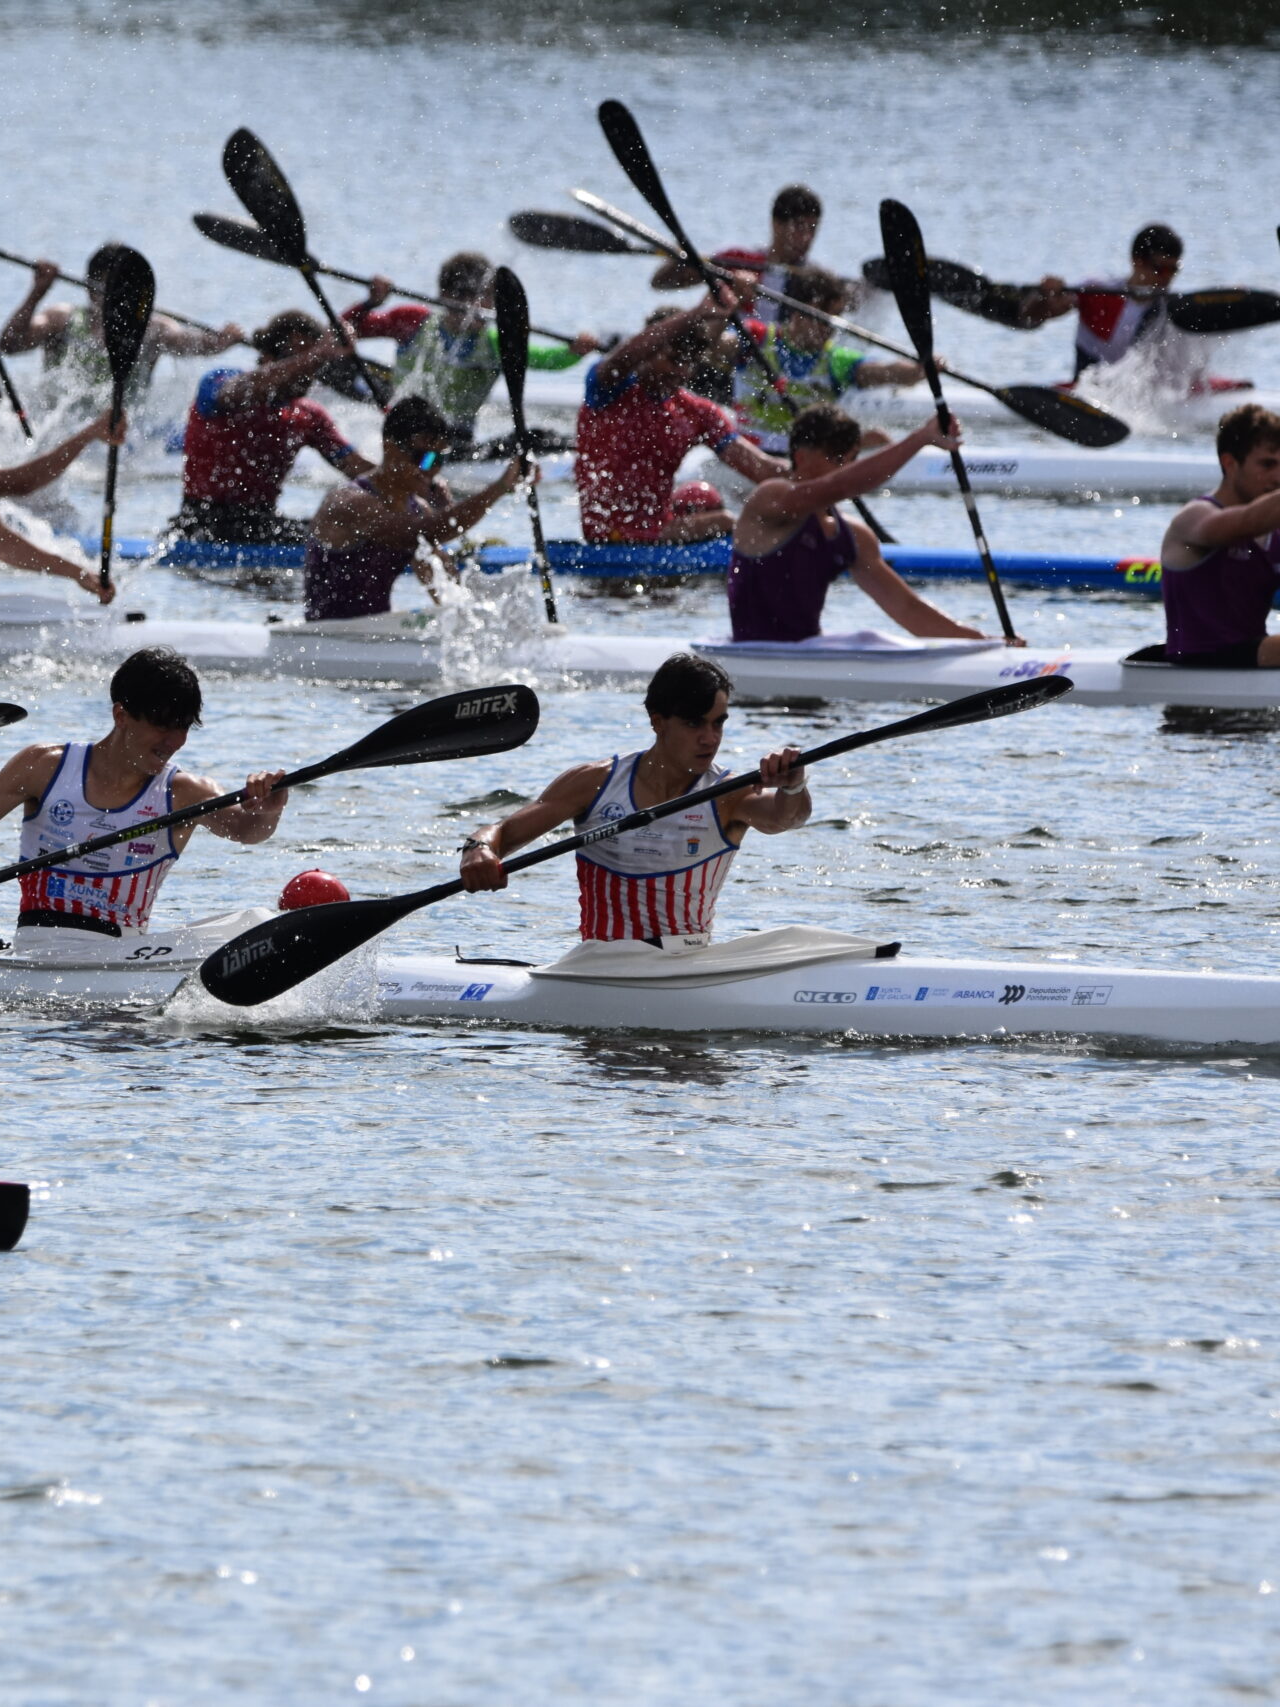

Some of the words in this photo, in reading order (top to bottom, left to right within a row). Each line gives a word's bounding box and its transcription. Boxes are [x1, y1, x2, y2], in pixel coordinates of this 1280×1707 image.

[69, 882, 109, 899] XUNTA
[952, 990, 995, 999] ABANCA
[1029, 986, 1071, 996] Deputación
[795, 991, 856, 1003] NELO
